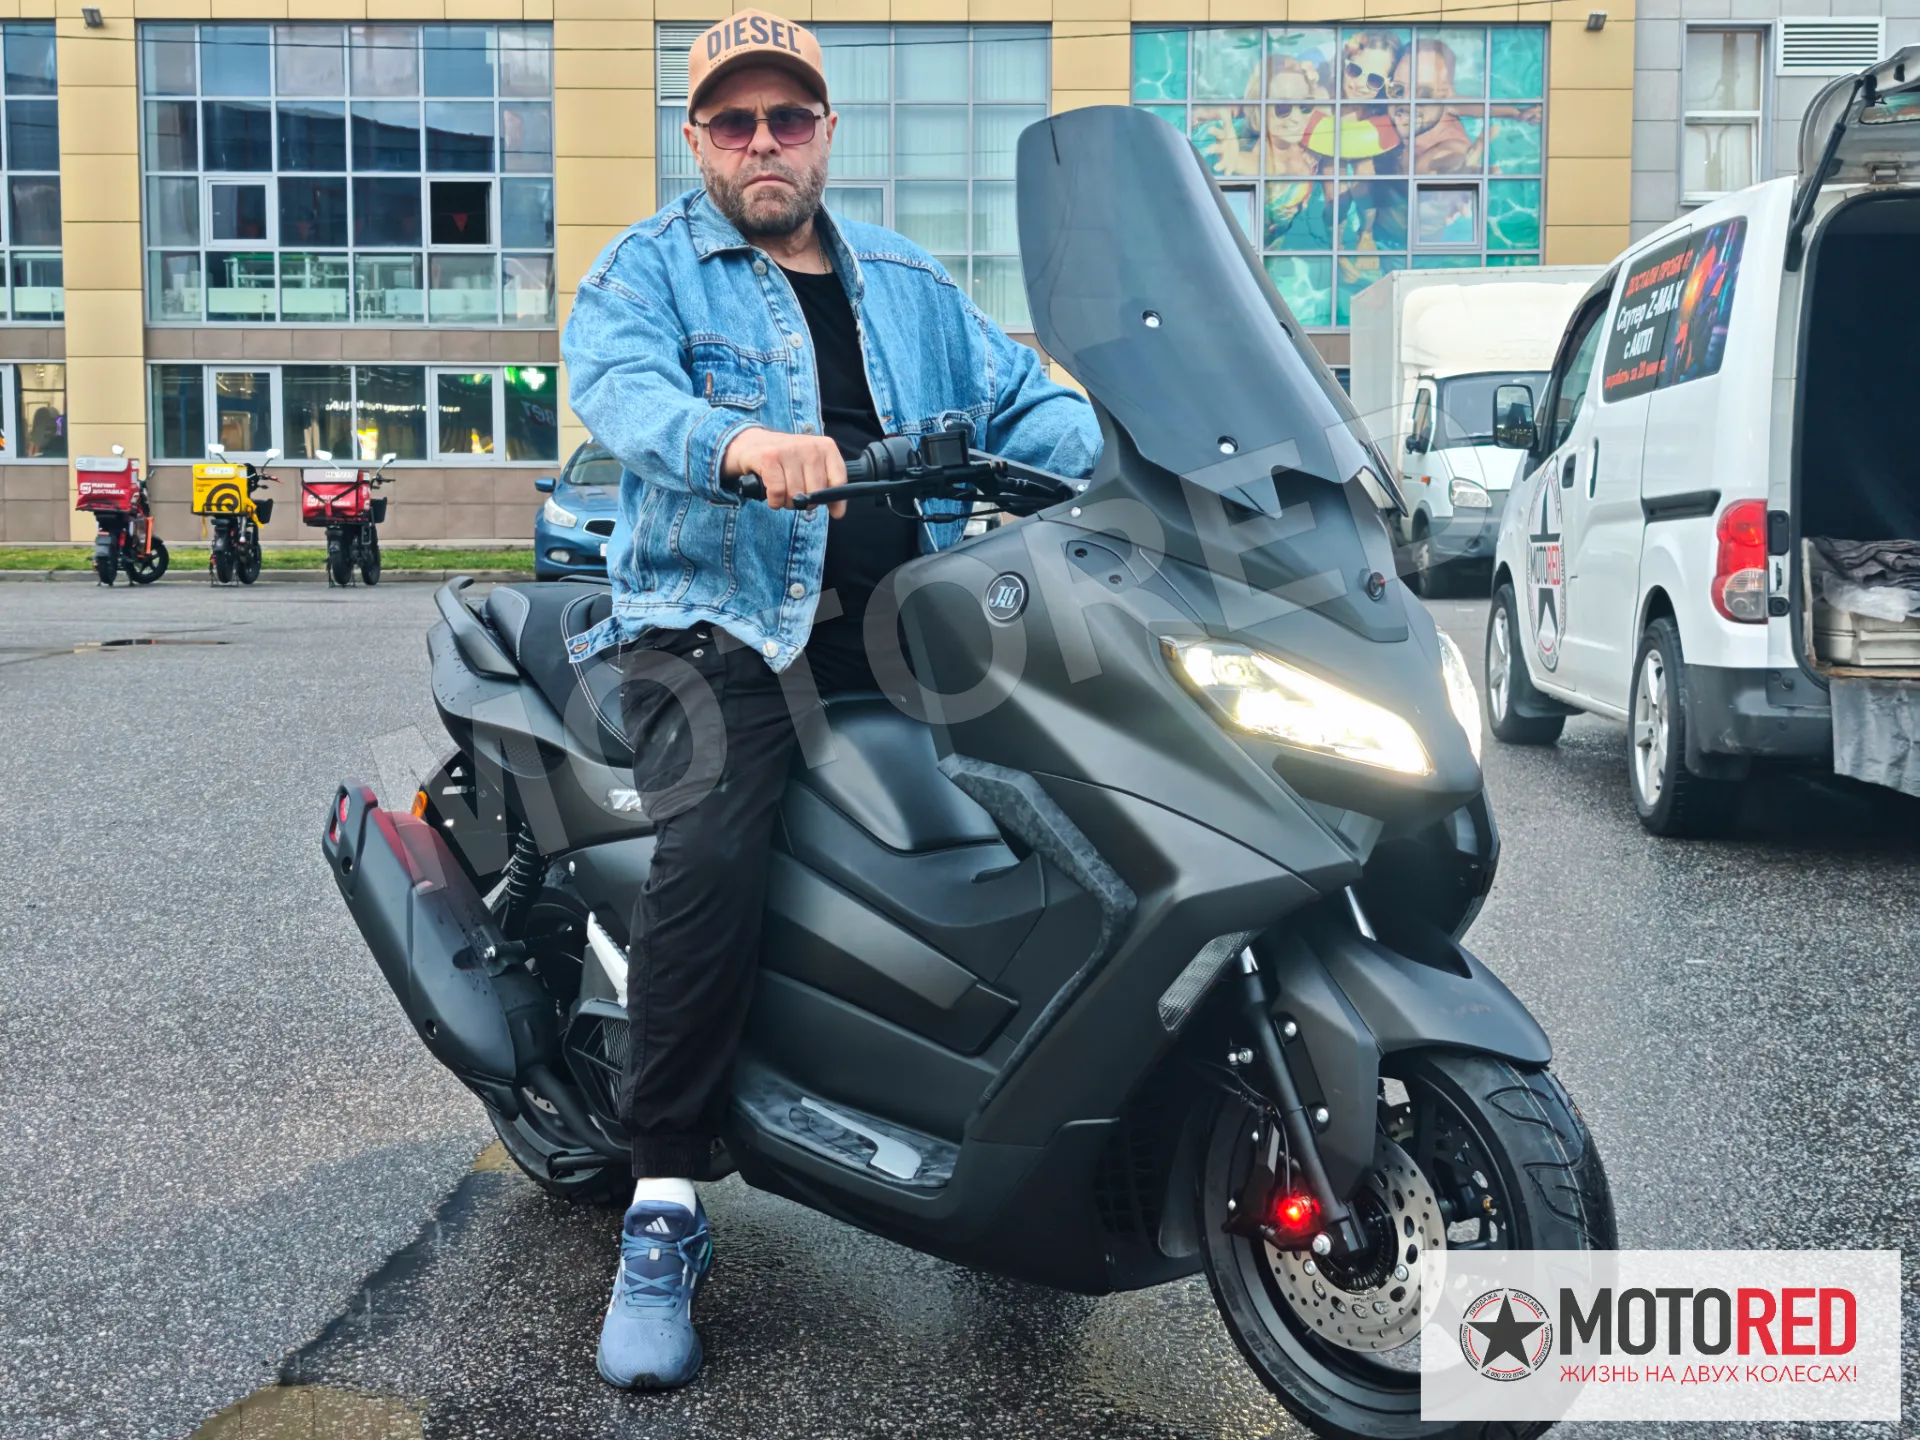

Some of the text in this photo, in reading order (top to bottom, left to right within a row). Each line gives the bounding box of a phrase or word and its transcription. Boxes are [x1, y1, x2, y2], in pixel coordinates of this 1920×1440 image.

[706, 16, 802, 61] DIESEL
[1616, 279, 1685, 335] Скутер Z-MAX
